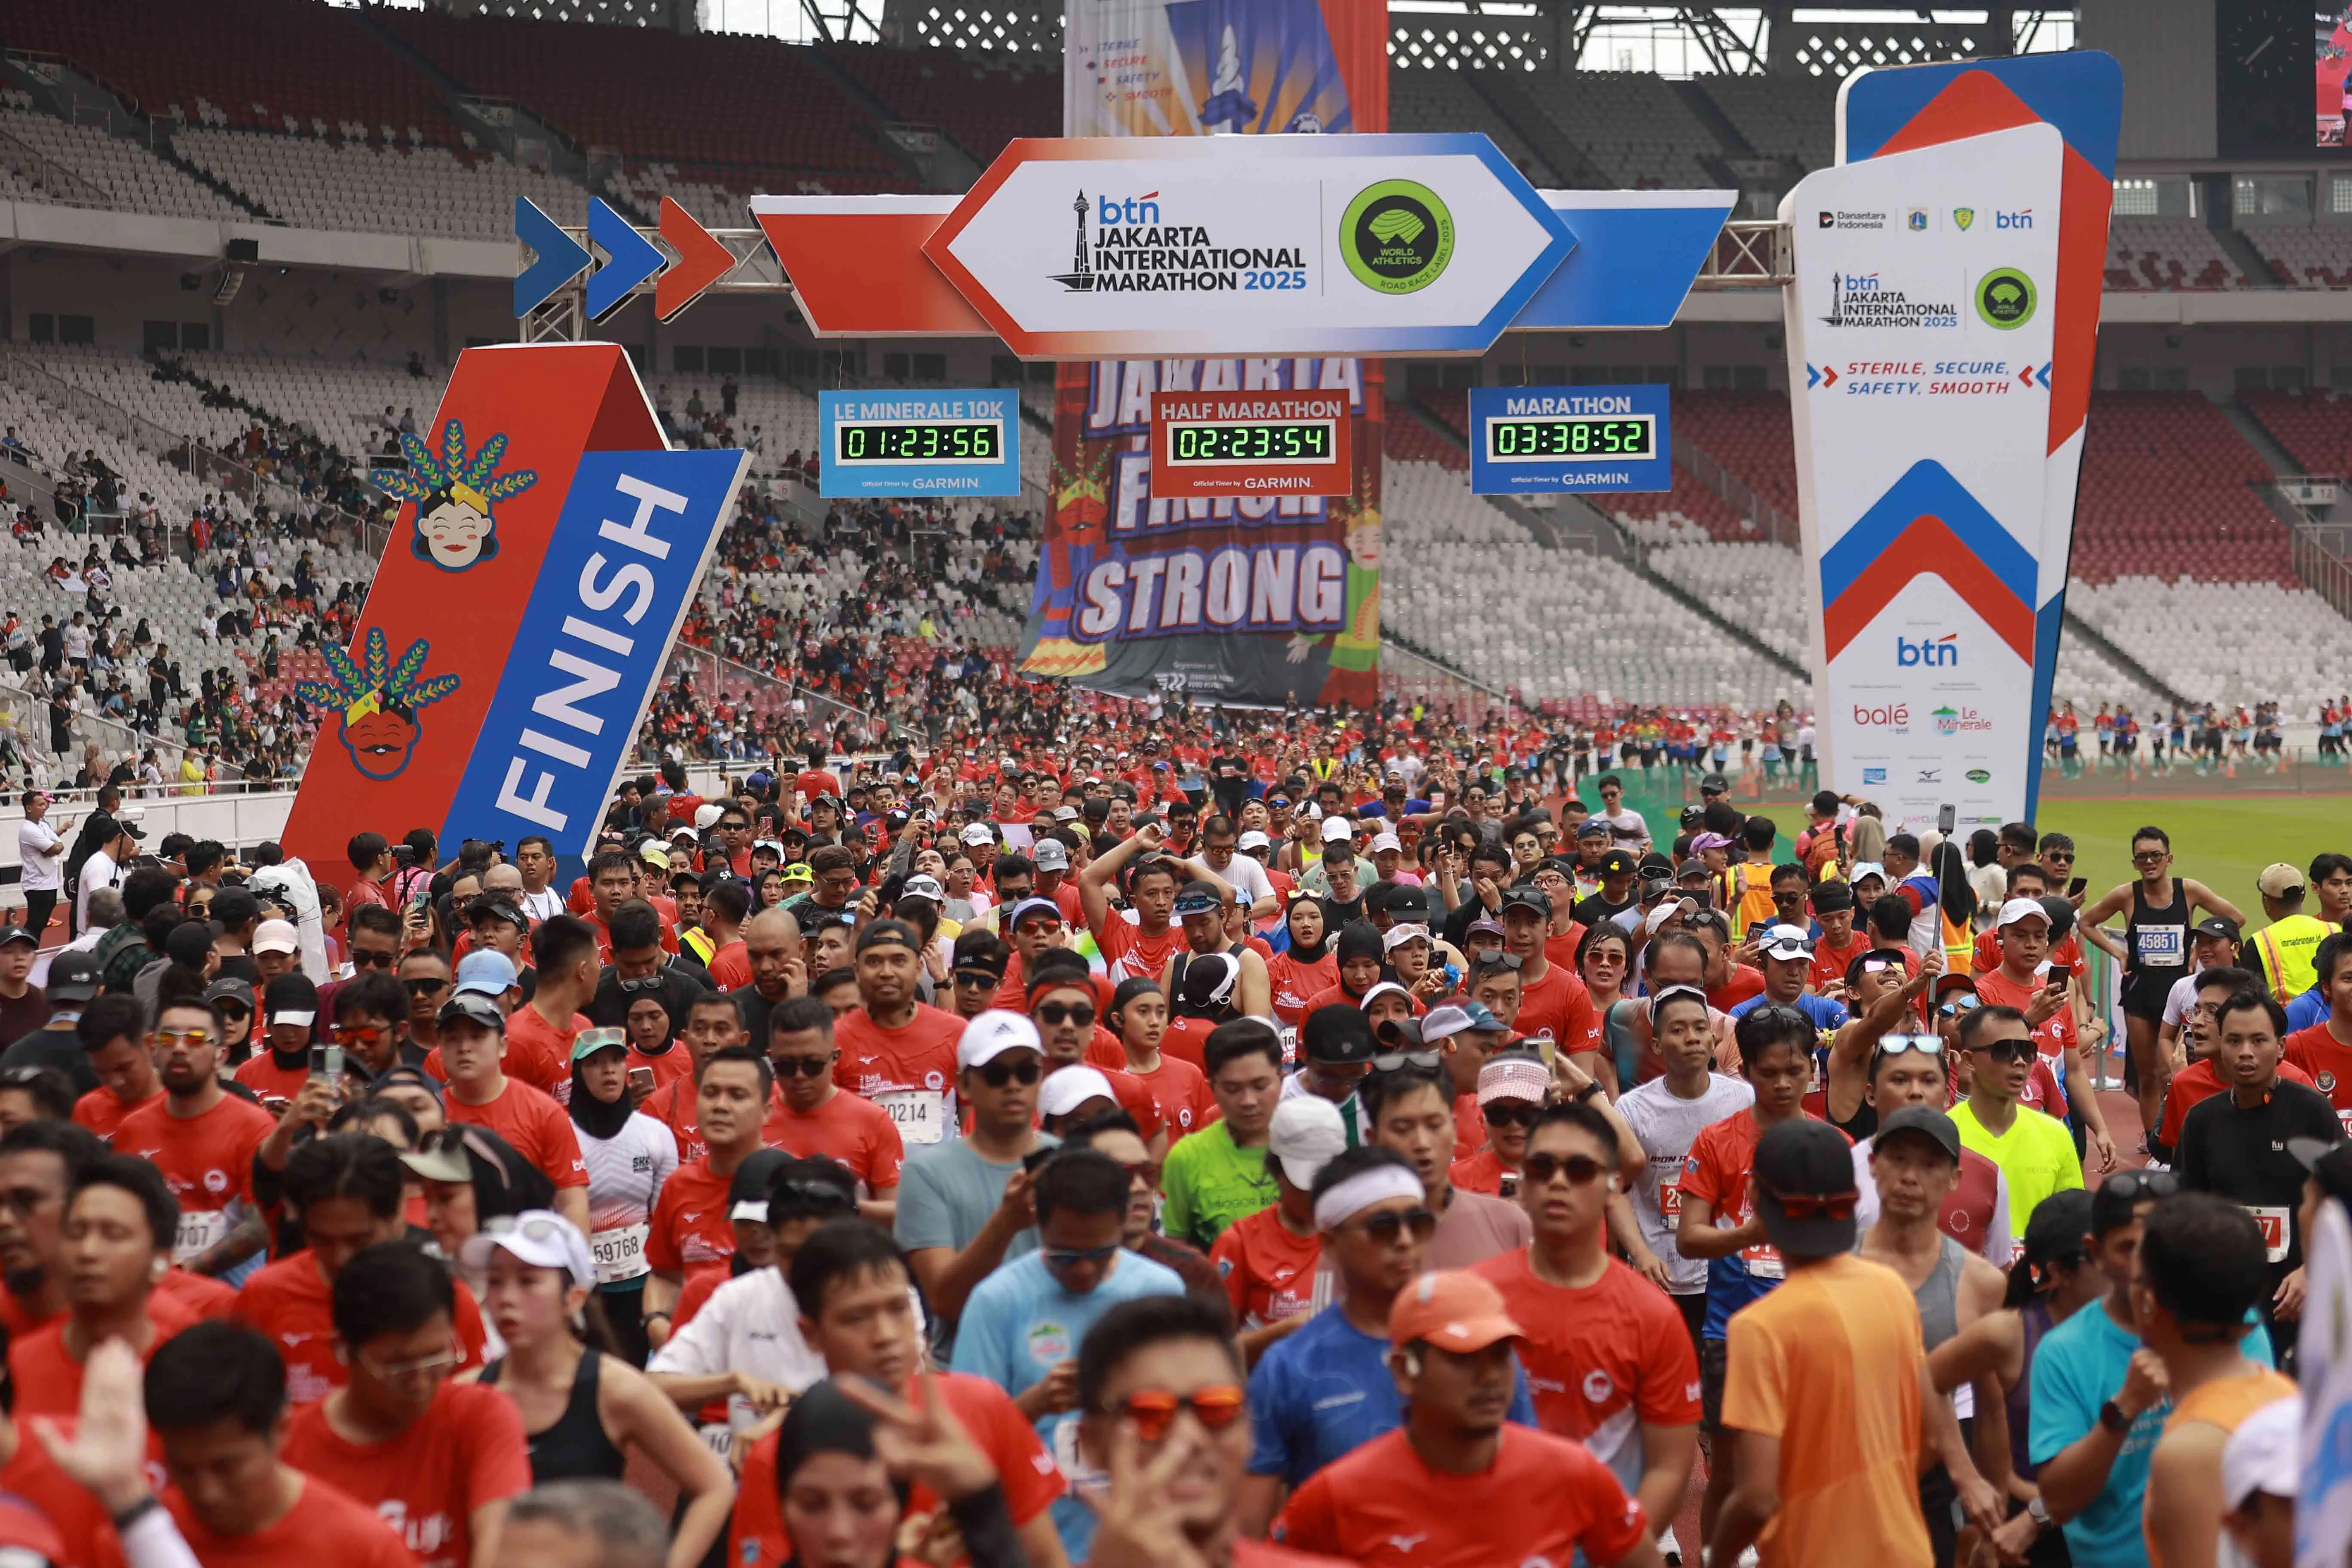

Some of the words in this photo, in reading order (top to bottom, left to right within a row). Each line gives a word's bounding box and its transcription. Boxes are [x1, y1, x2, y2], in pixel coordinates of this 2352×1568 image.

[1103, 55, 1148, 69] SECURE
[1116, 72, 1160, 86] SAFETY
[1837, 211, 1886, 220] Danantara
[1837, 220, 1883, 229] Indonesia
[1094, 227, 1210, 248] JAKARTA
[1096, 248, 1306, 270] INTERNATIONAL
[1380, 248, 1414, 256] WORLD
[1380, 280, 1406, 289] ROAD
[1409, 271, 1432, 287] RACE
[1430, 247, 1449, 273] LABEL
[1440, 219, 1449, 243] 2025
[1372, 256, 1422, 265] ATHLETICS
[1096, 272, 1237, 292] MARATHON
[1244, 271, 1306, 290] 2025
[1843, 292, 1905, 304] JAKARTA
[1844, 303, 1957, 316] INTERNATIONAL
[1844, 316, 1920, 328] MARATHON
[1923, 316, 1957, 327] 2025
[1847, 362, 1926, 377] STERILE,
[1934, 361, 2009, 375] SECURE,
[1847, 382, 1921, 396] SAFETY,
[1929, 382, 2010, 395] SMOOTH
[834, 403, 855, 420] LE
[861, 401, 963, 420] MINERALE
[969, 401, 1004, 418] 10K
[1161, 402, 1213, 420] HALF
[1218, 401, 1342, 419] MARATHON
[1506, 396, 1631, 415] MARATHON
[848, 428, 989, 457] 01:23:56
[1179, 428, 1322, 457] 02:23:54
[1498, 423, 1642, 454] 03:38:52
[912, 477, 979, 489] GARMIN
[1244, 477, 1311, 489] GARMIN
[1562, 472, 1629, 485] GARMIN
[1079, 545, 1345, 637] STRONG
[495, 473, 689, 833] FINISH
[1962, 707, 1977, 720] Le
[1937, 719, 1992, 731] Minerale
[2138, 934, 2176, 949] 45851
[594, 1236, 640, 1264] 59768
